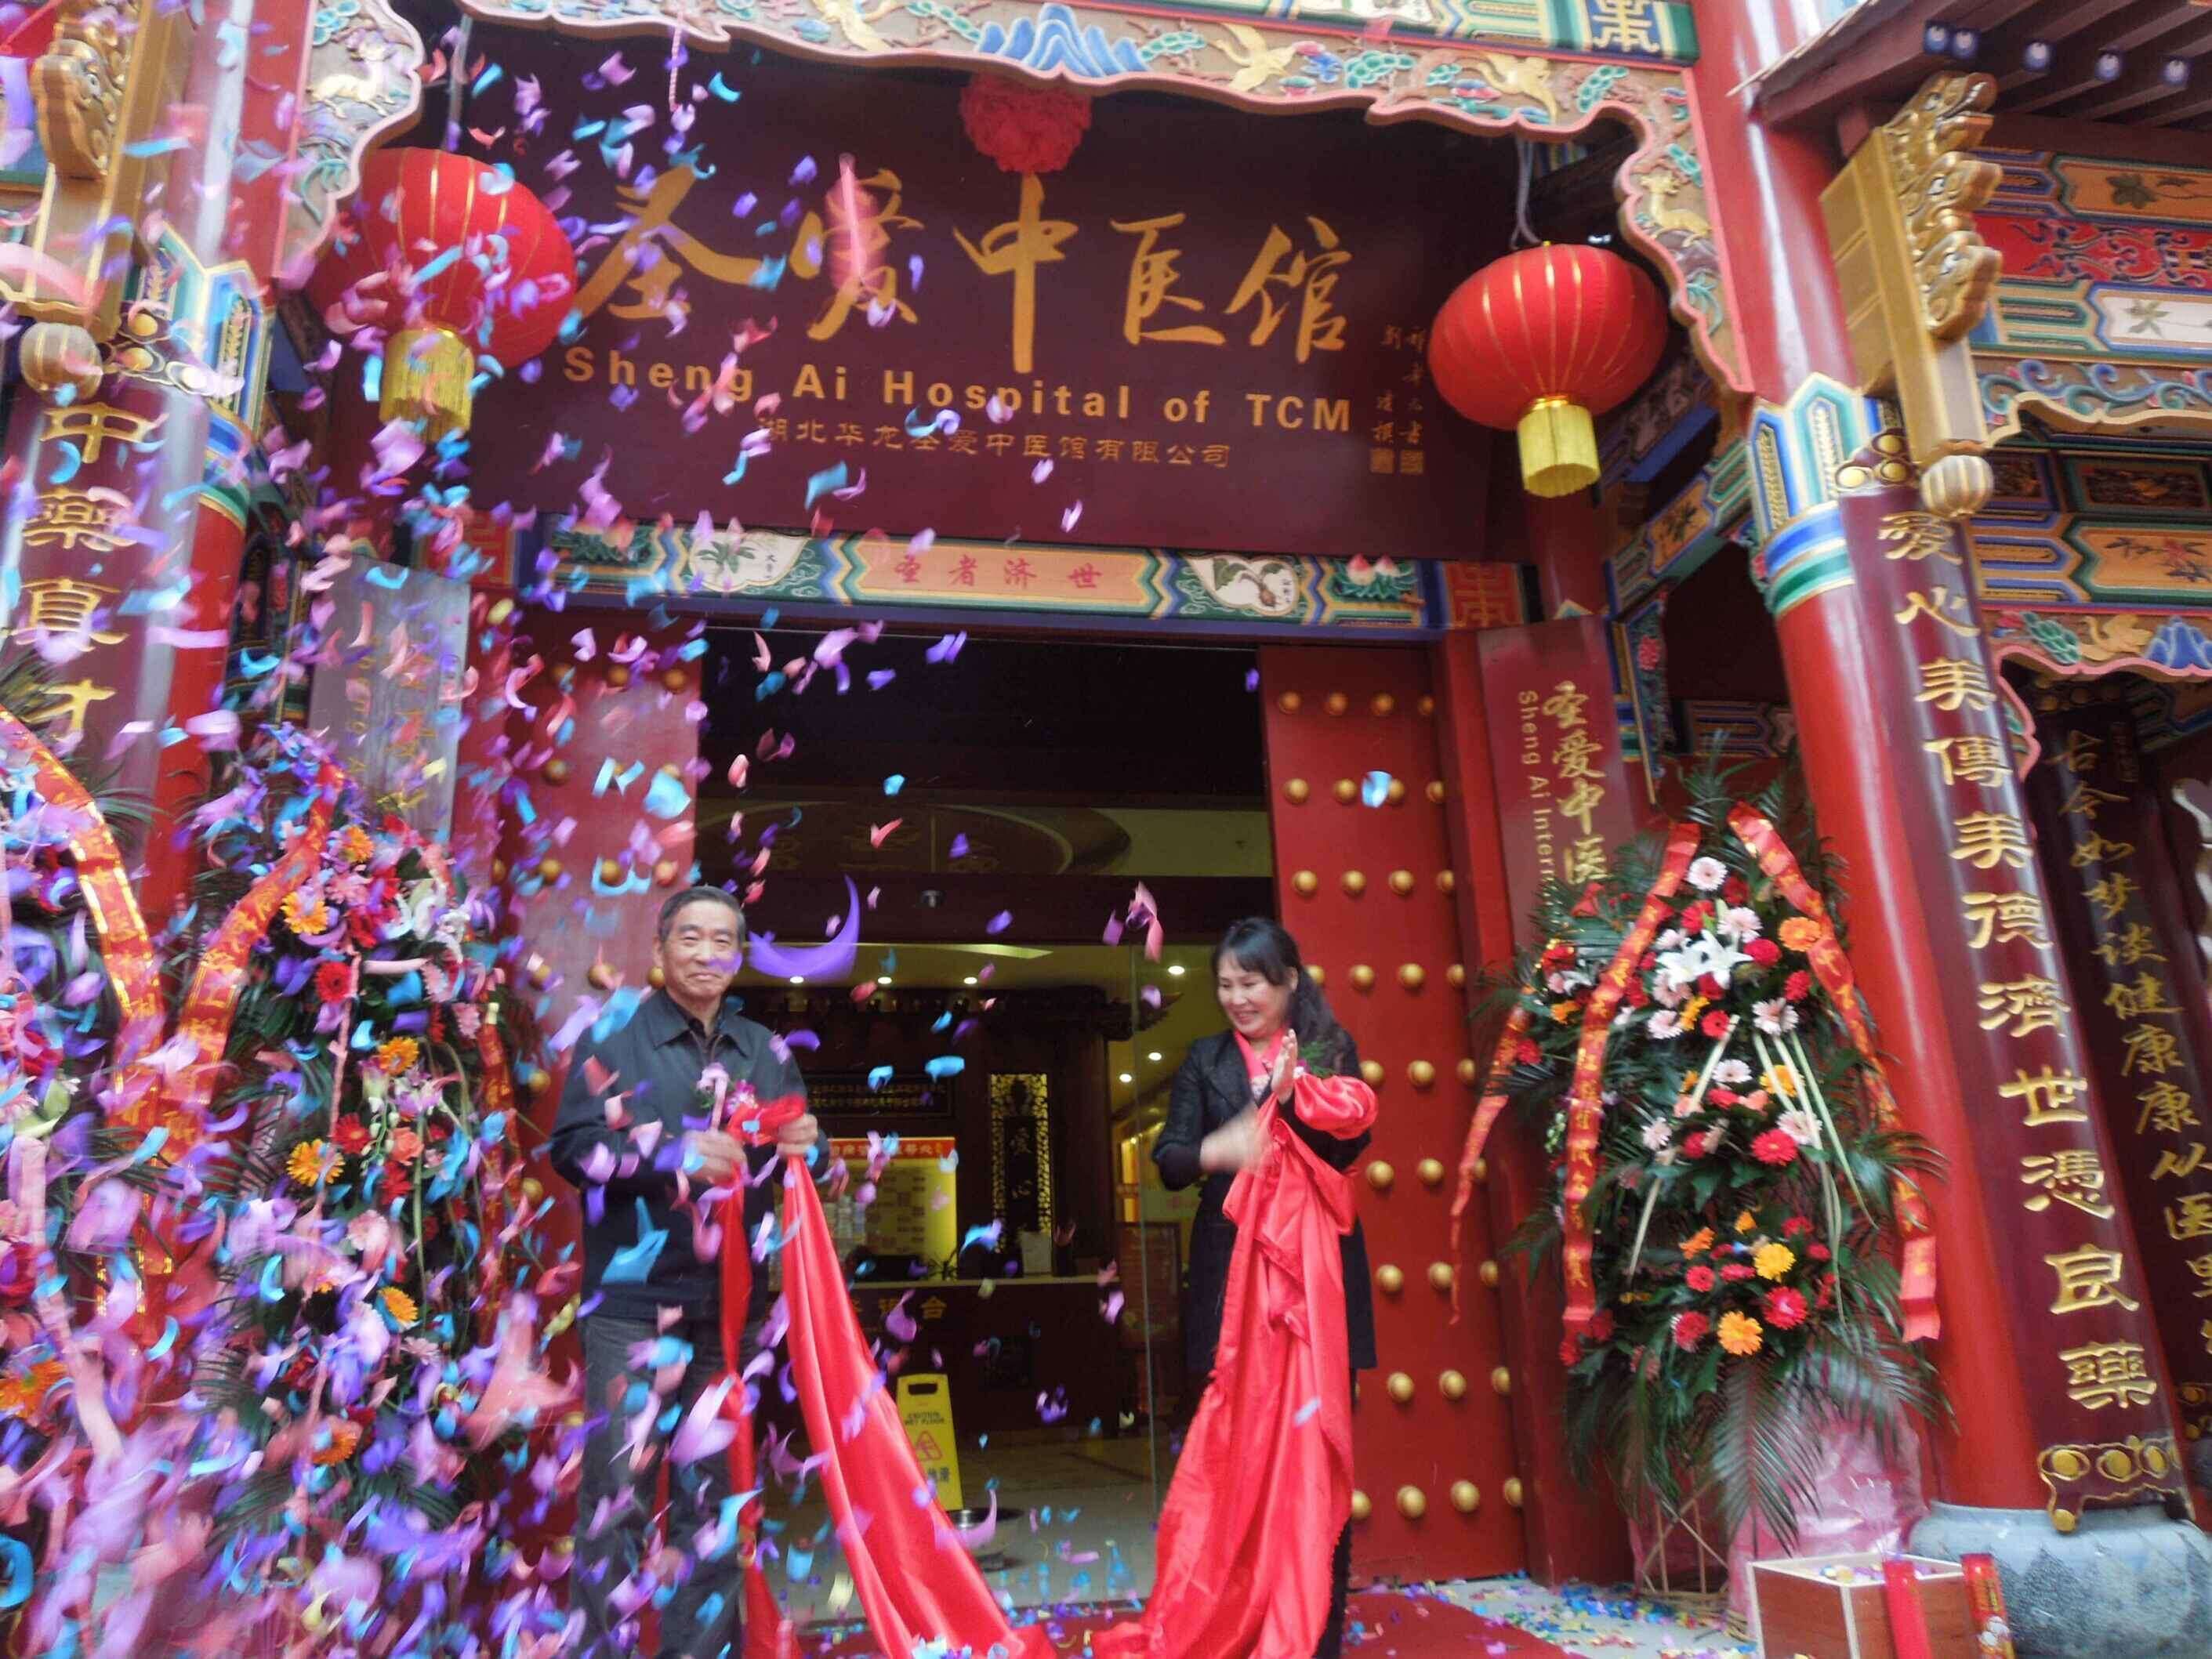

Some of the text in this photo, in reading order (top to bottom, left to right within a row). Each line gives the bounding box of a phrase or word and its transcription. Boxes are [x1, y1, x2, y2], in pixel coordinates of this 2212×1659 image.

[564, 346, 1351, 432] Sheng Ai Hospital of TCM
[1518, 690, 1556, 882] Sheng Ai Intern
